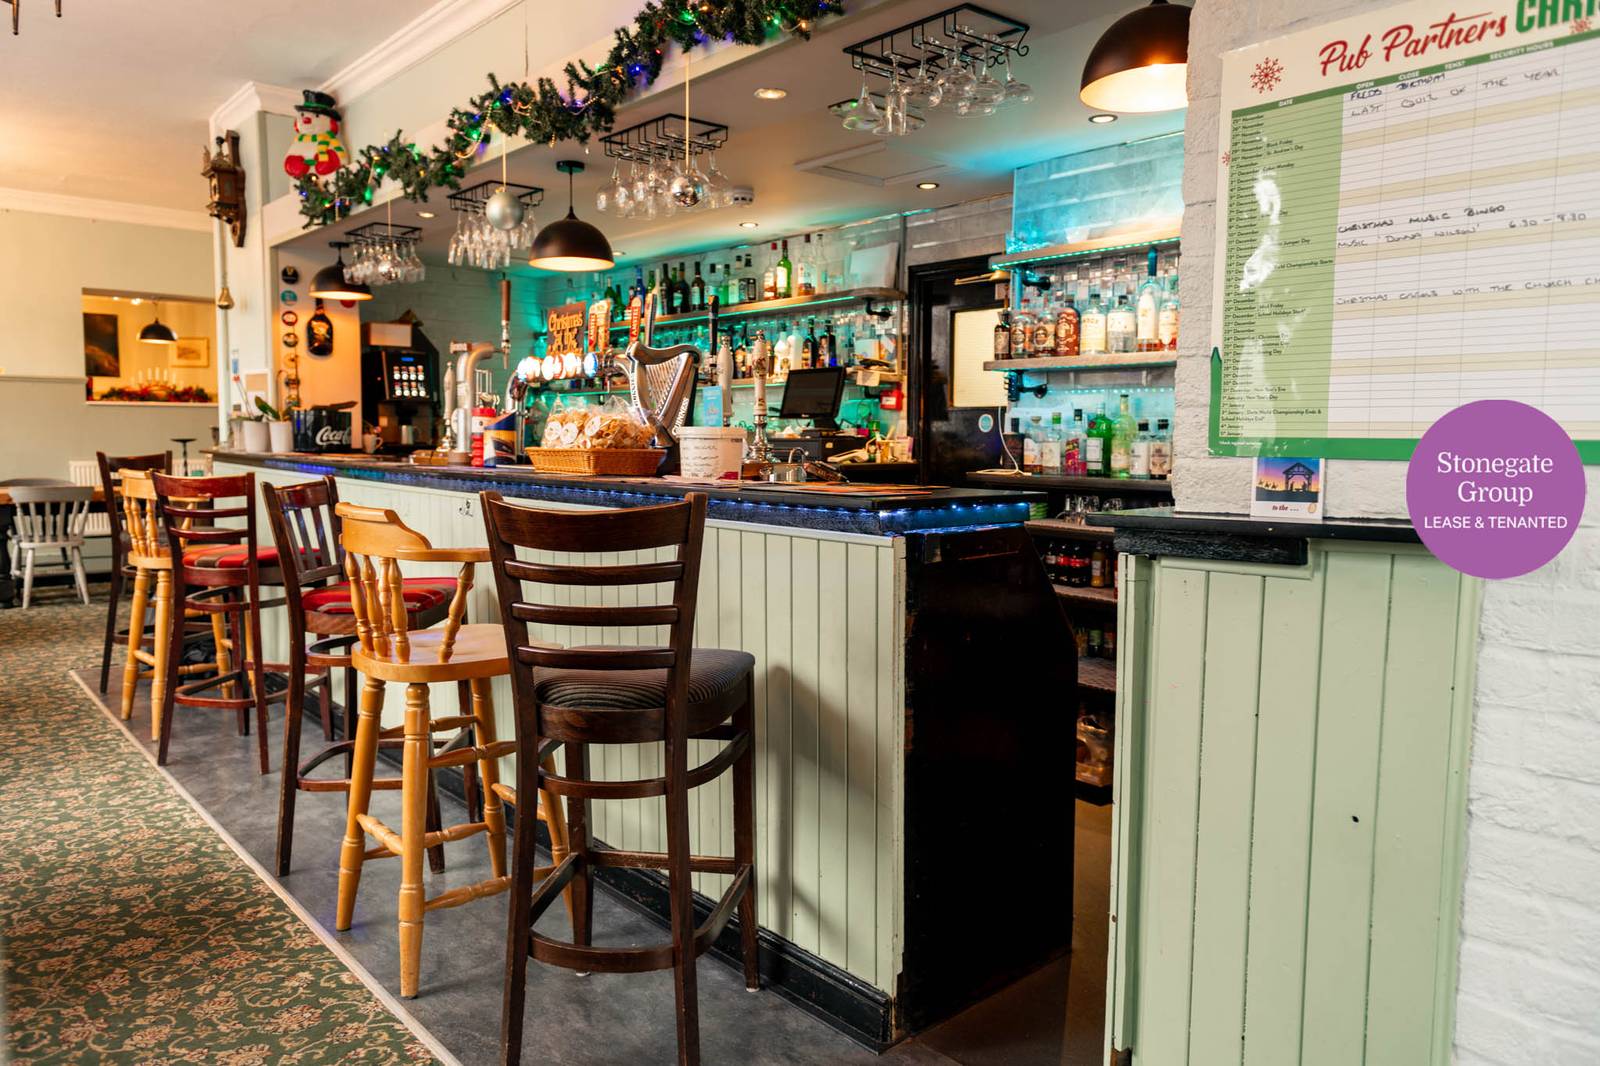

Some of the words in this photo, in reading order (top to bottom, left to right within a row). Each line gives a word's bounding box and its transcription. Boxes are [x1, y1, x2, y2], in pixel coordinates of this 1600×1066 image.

[1319, 34, 1373, 76] Pub
[1381, 12, 1508, 62] Partners
[1408, 212, 1451, 224] MUSIC
[1463, 204, 1505, 217] BINGO
